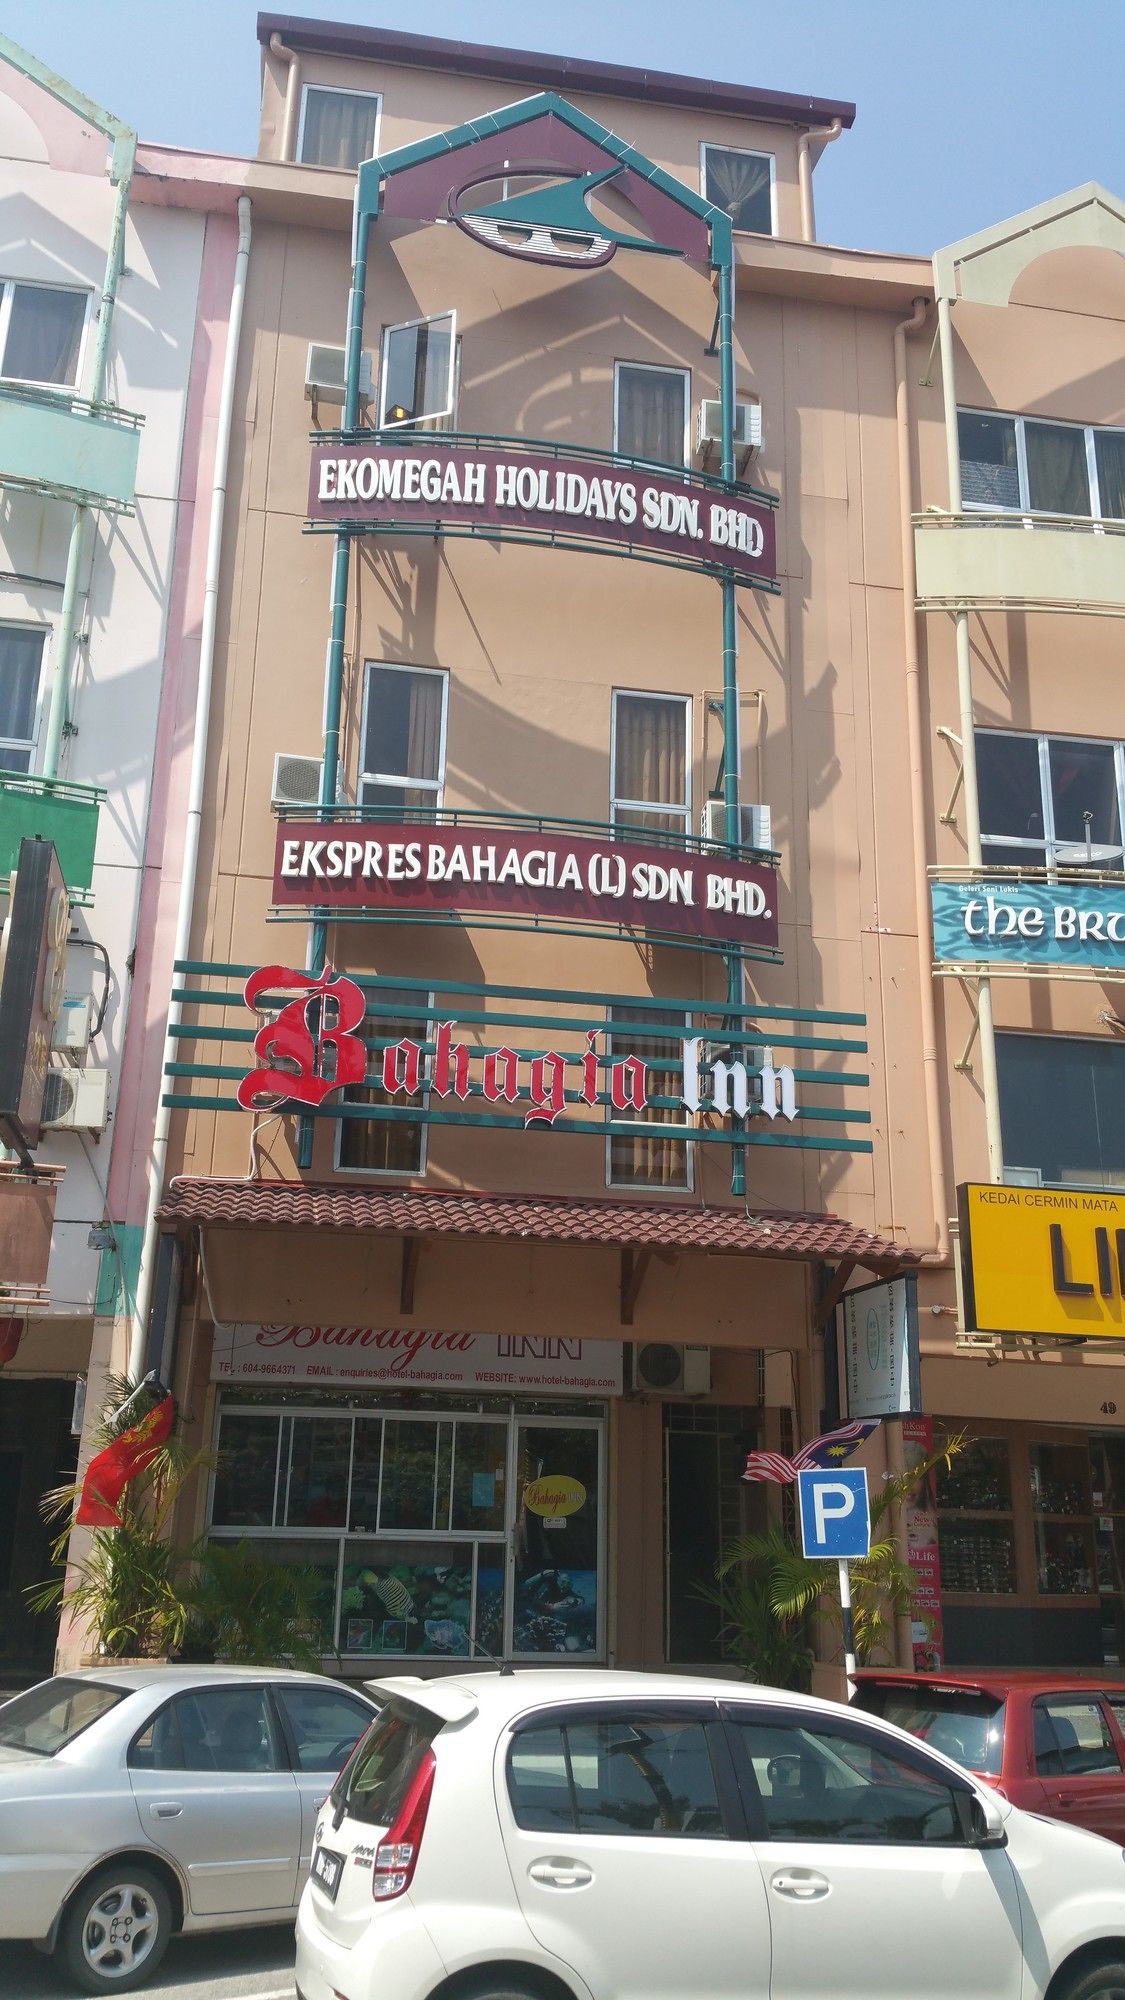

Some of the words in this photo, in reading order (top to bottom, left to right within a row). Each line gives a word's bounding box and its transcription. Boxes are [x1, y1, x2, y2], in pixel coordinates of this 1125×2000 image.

[318, 457, 487, 504] EKOMEGAH
[495, 464, 638, 525] HOLIDAYS
[642, 487, 704, 540] SDN.
[710, 504, 764, 558] BHD
[280, 840, 421, 880] EKSPRES
[427, 844, 584, 891] BAHAGIA
[632, 862, 695, 907] SDN
[706, 873, 772, 919] BHD.
[1000, 886, 1018, 894] Lukis
[961, 896, 1045, 937] the
[236, 964, 649, 1130] Bahagia
[680, 1036, 801, 1123] Inn
[980, 1191, 1020, 1205] KEDAI
[1025, 1194, 1078, 1209] CERMIN
[1082, 1198, 1118, 1212] MATA
[242, 1363, 296, 1375] 604-9664371
[307, 1365, 334, 1376] EMAIL
[475, 1371, 517, 1384] WEBSITE:
[519, 1375, 616, 1388] www.hotel-bahagia.com
[1100, 1401, 1117, 1415] 49
[813, 1483, 855, 1544] P
[916, 1551, 936, 1561] Life
